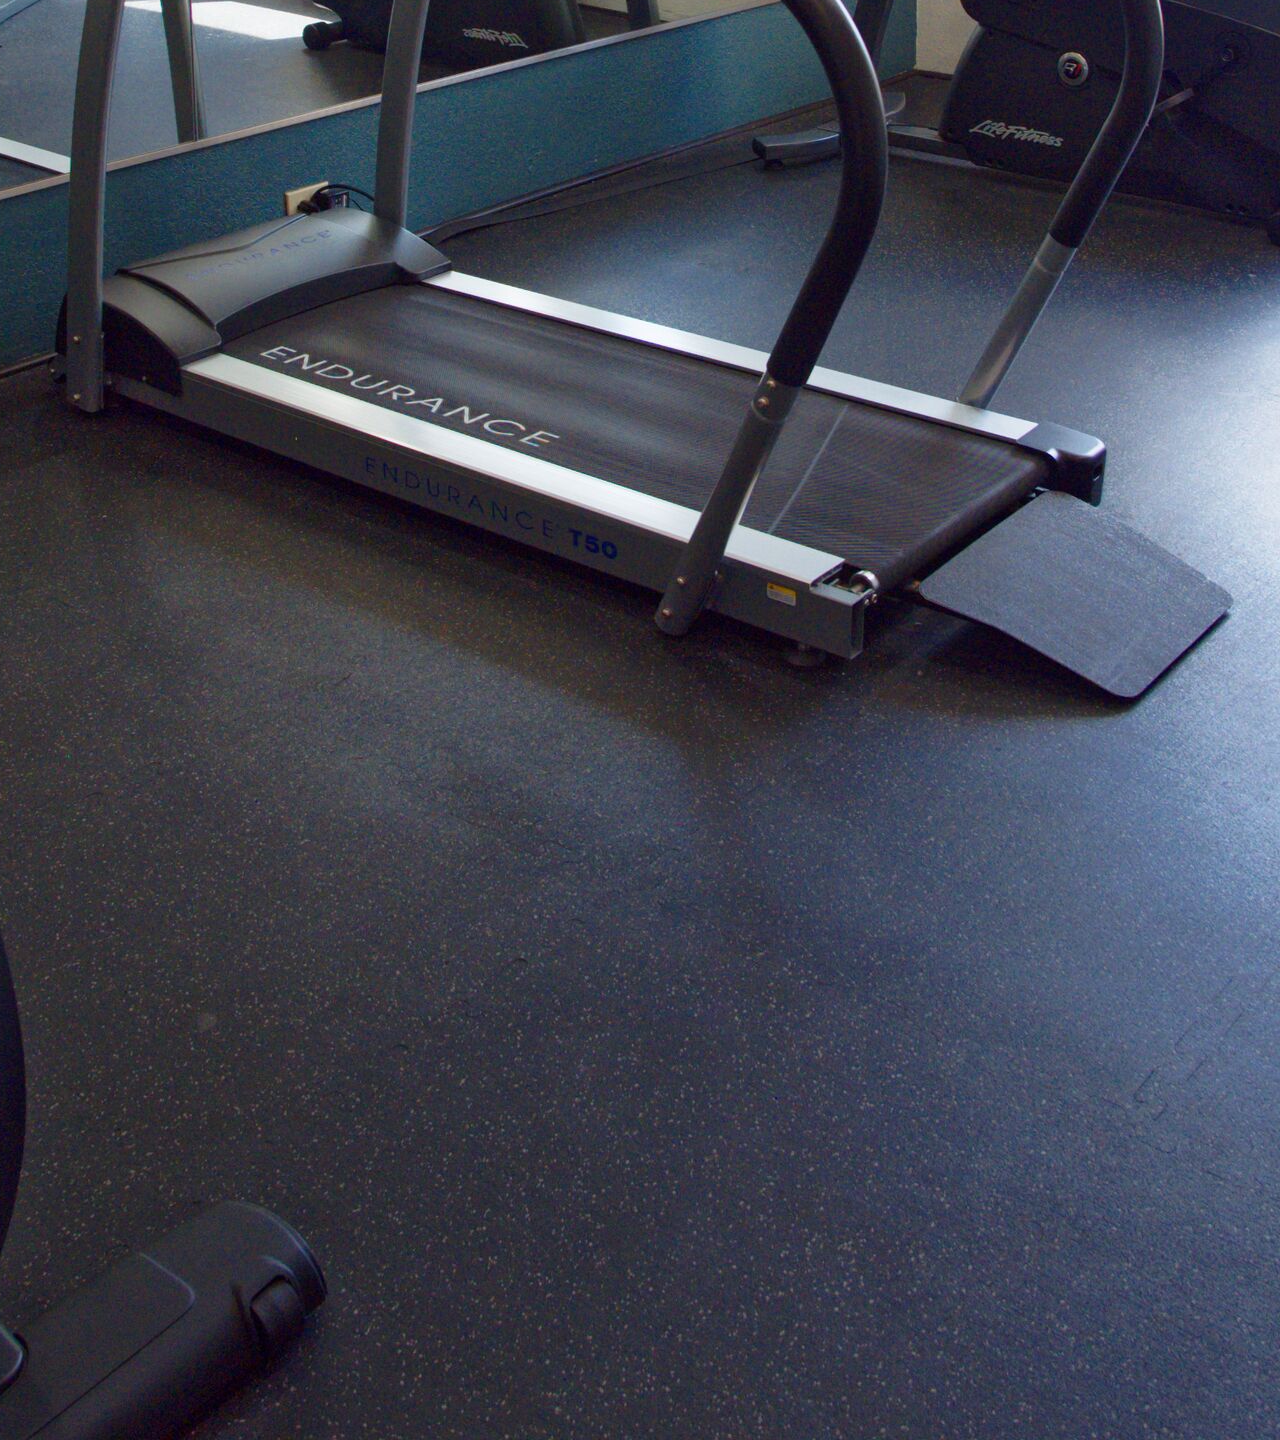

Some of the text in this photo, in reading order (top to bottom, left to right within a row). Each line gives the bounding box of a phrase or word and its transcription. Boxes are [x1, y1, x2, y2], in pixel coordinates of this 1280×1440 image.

[259, 344, 561, 448] ENDURANCE
[364, 456, 619, 561] ENDURANCE T50
